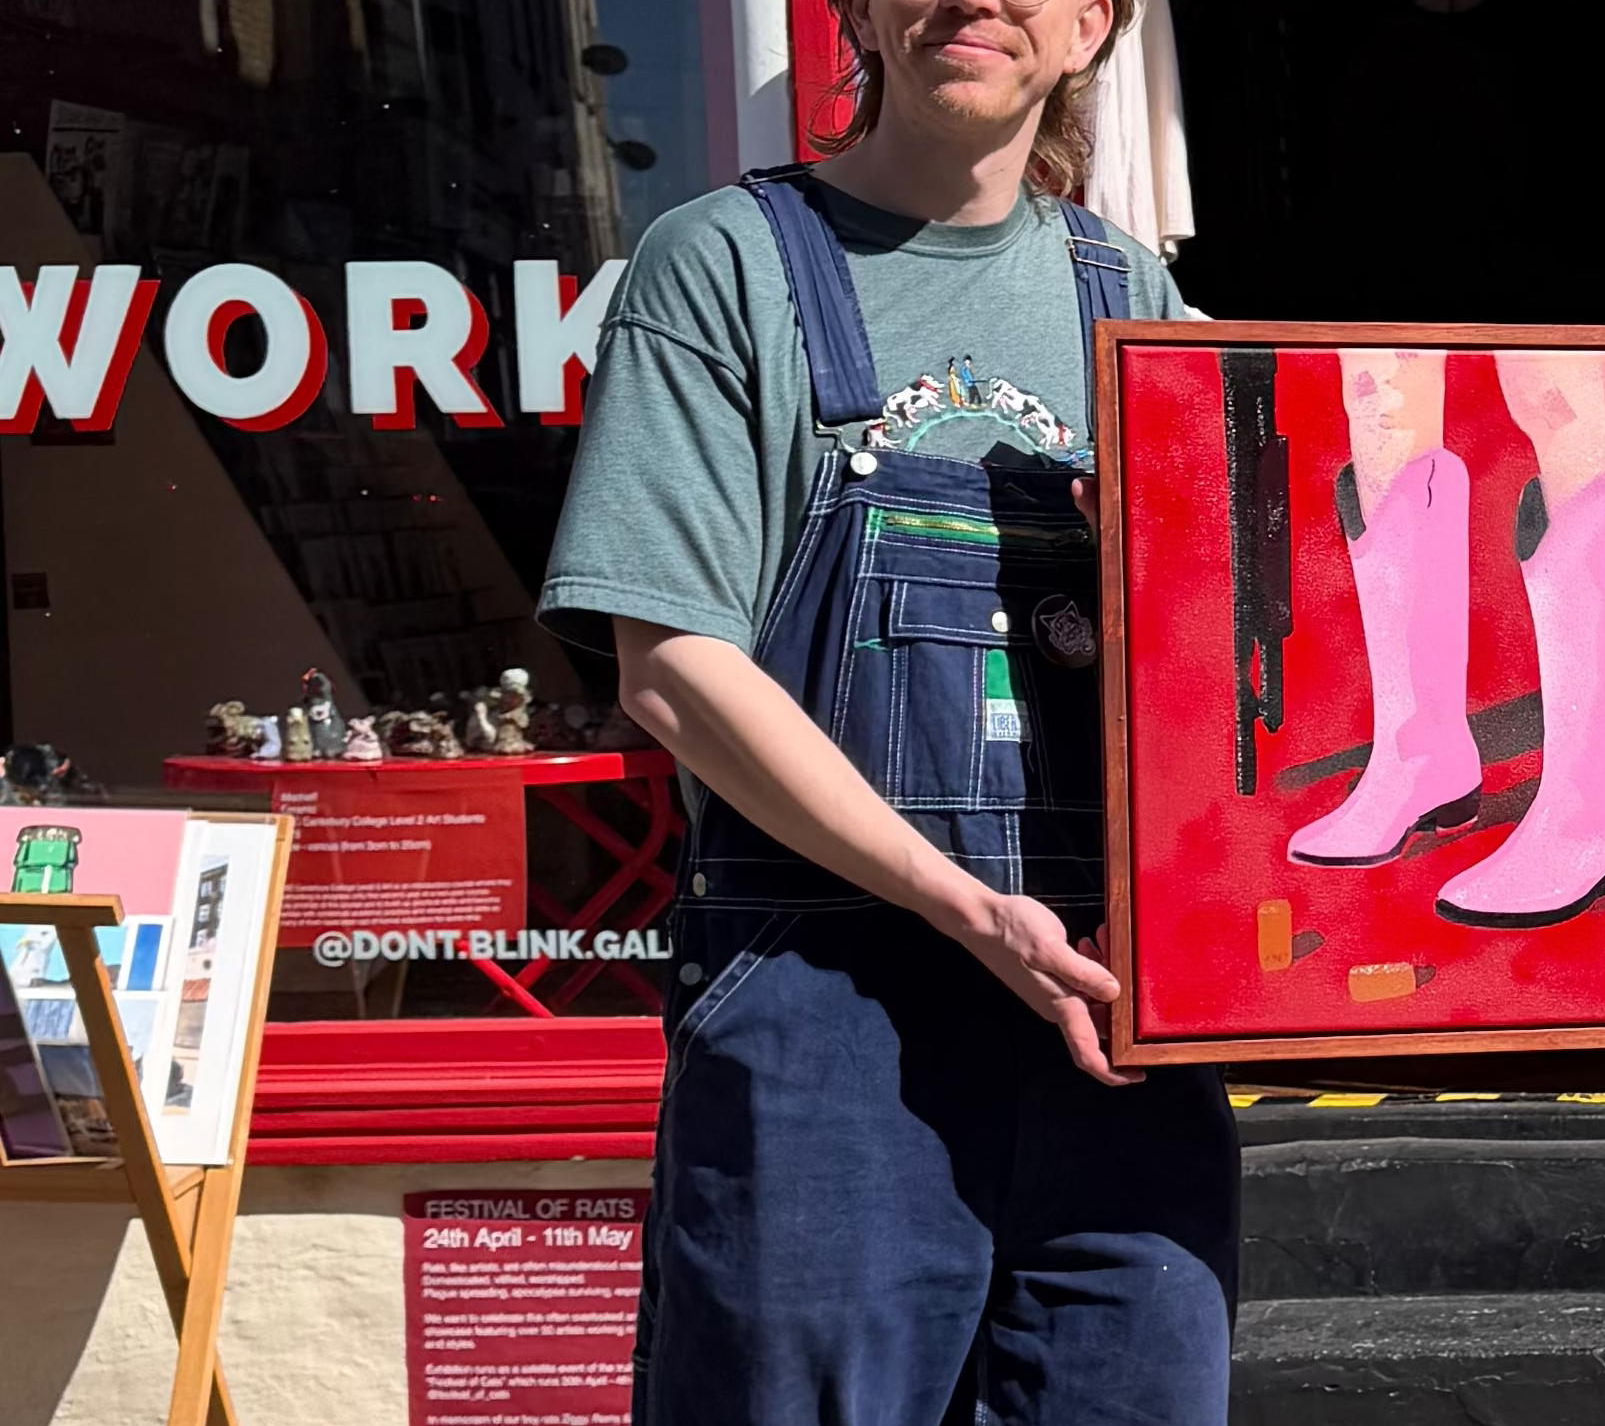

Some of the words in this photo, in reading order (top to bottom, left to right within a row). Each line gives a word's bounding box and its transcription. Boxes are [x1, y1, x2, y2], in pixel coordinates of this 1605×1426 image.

[425, 1200, 531, 1220] FESTIVAL
[535, 1199, 570, 1219] OF
[575, 1198, 636, 1219] RATS
[422, 1227, 469, 1249] 24th
[473, 1226, 522, 1252] April
[542, 1226, 583, 1246] 11th
[587, 1225, 634, 1251] May
